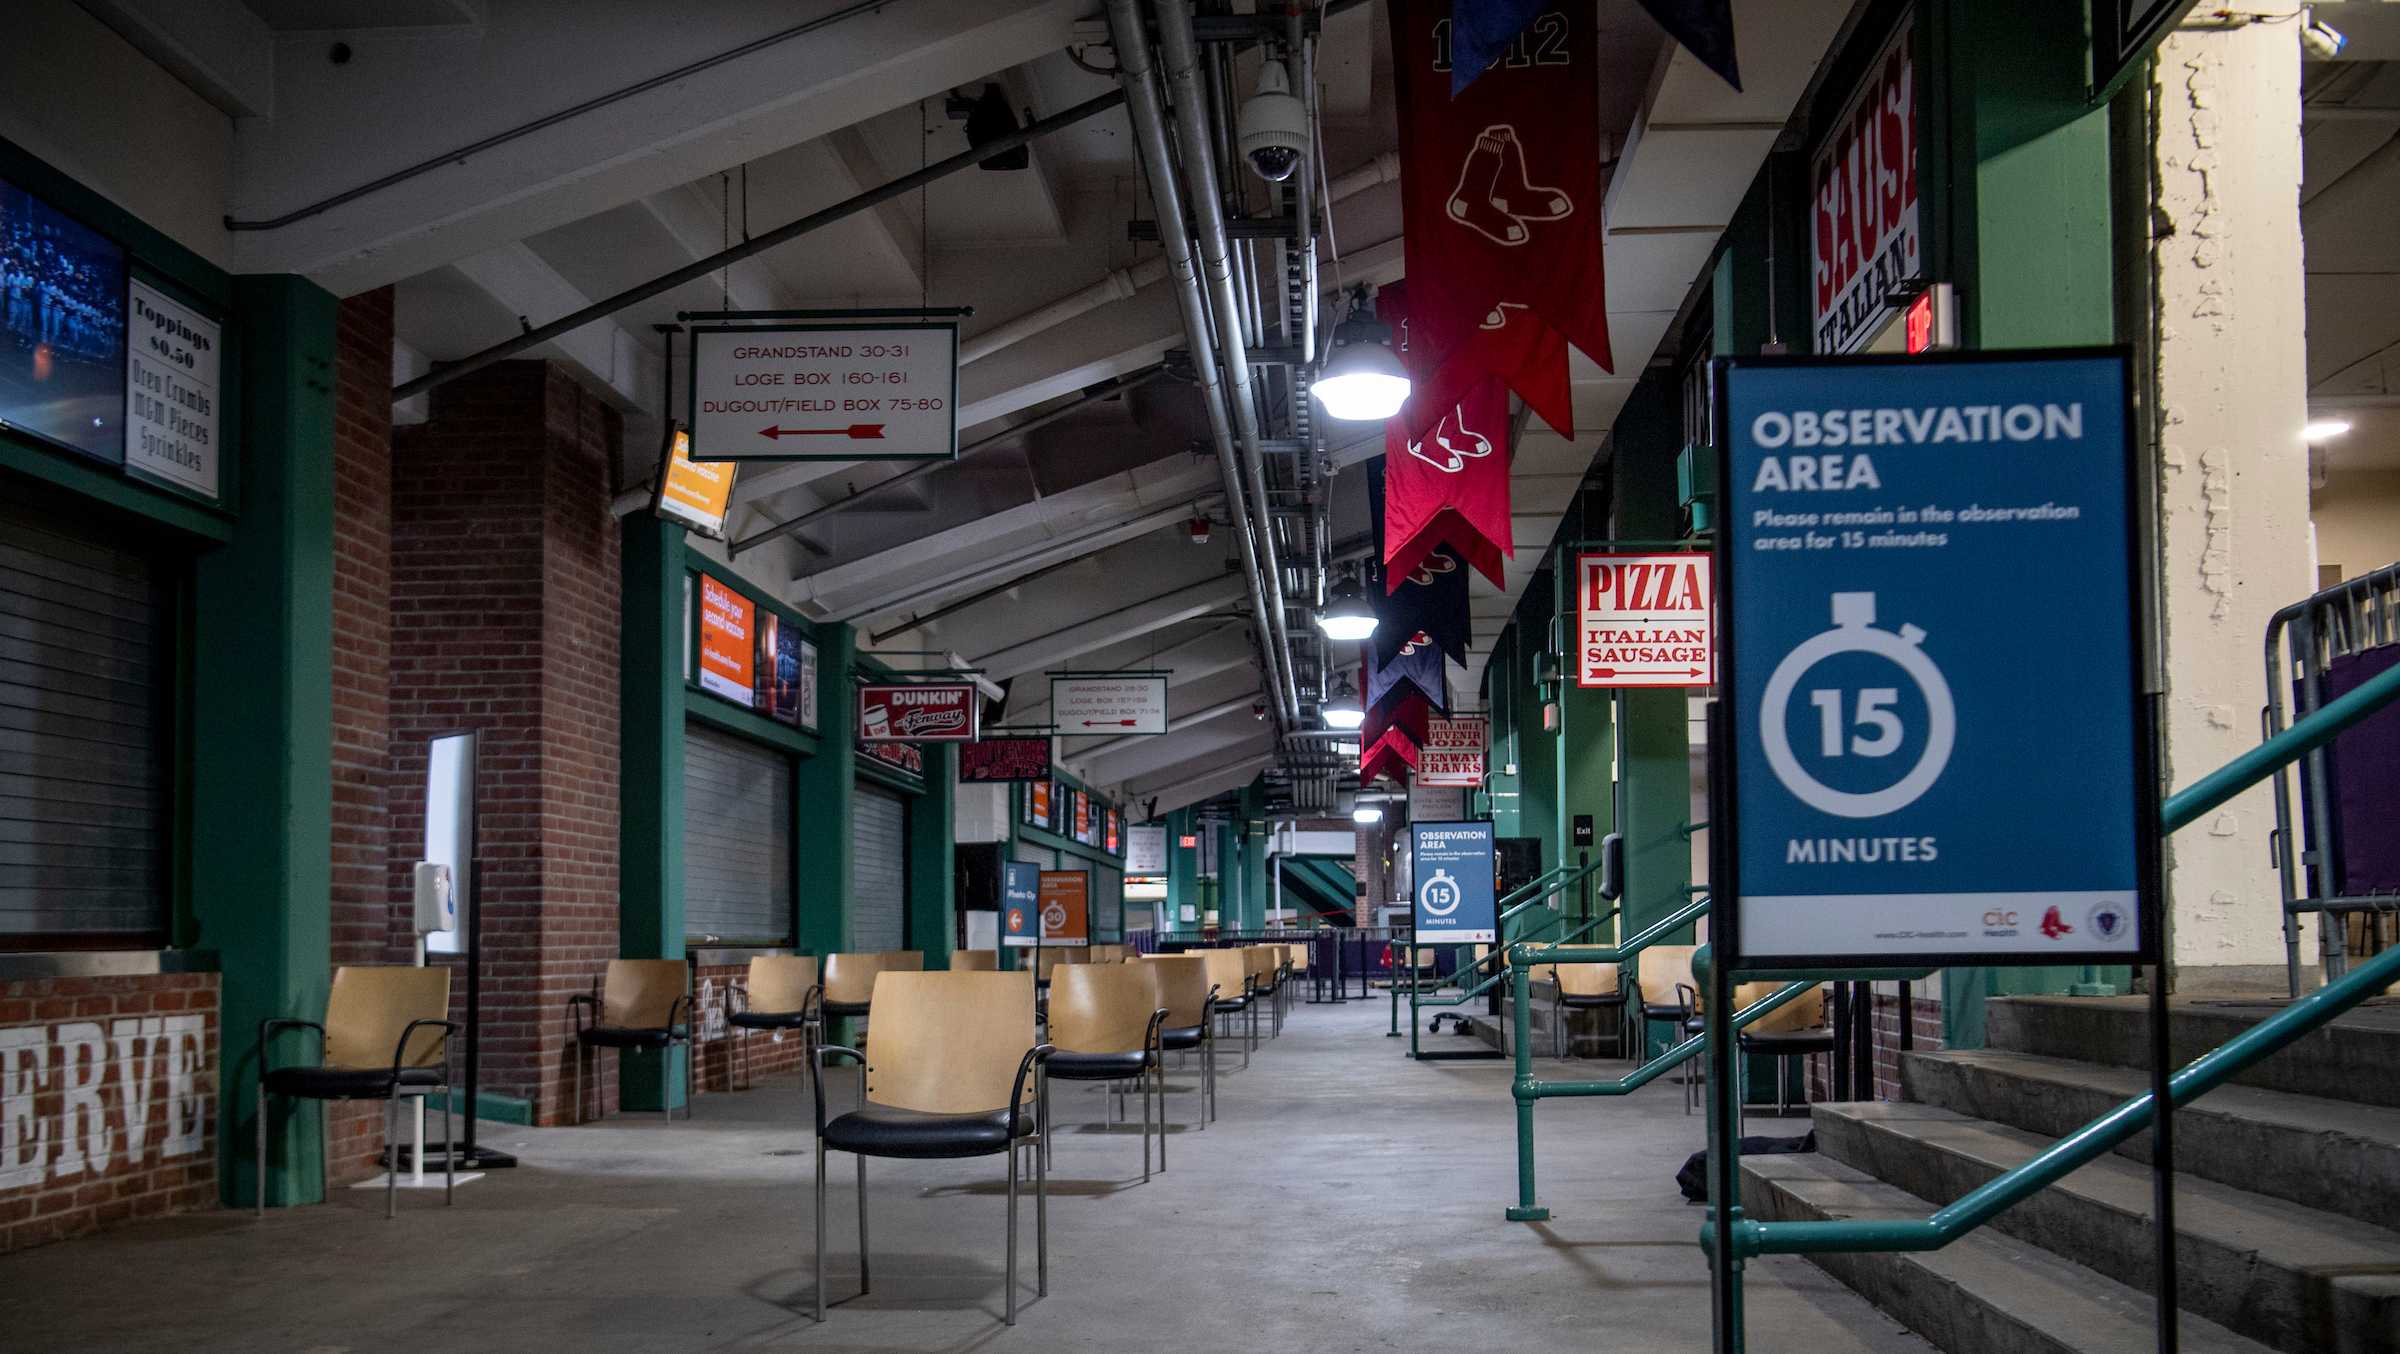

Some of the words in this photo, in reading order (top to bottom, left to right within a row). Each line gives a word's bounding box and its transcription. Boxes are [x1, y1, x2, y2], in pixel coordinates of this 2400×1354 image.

[1432, 12, 1569, 72] 112
[1819, 229, 1907, 355] ITALIAN
[135, 297, 210, 350] Toppings
[151, 335, 194, 369] $0.50
[734, 346, 852, 360] GRANDSTAND
[860, 345, 909, 357] 30-31
[133, 359, 162, 393] Oreo
[166, 375, 210, 417] Crumbs
[735, 373, 784, 385] LOGE
[795, 373, 830, 385] BOX
[842, 371, 907, 384] 160-161
[703, 397, 836, 414] DUGOUT/FIELD
[844, 399, 880, 411] BOX
[890, 398, 943, 410] 75-80
[170, 406, 209, 445] Pieces
[1751, 403, 2082, 448] OBSERVATION
[141, 425, 201, 472] Sprinkles
[1752, 454, 1881, 492] AREA
[1753, 508, 1818, 527] Please
[1823, 507, 1893, 525] remain
[1898, 506, 1918, 523] in
[1920, 505, 1954, 522] the
[1957, 502, 2079, 522] observation
[1754, 536, 1801, 550] area
[1805, 532, 1836, 549] for
[1841, 532, 1864, 547] 15
[1868, 530, 1948, 547] minutes
[1587, 564, 1704, 611] PIZZA
[1588, 630, 1705, 643] ITALIAN
[1587, 648, 1705, 662] SAUSAGE
[891, 691, 963, 706] DUNKIN'
[901, 707, 965, 731] Fenway
[1811, 687, 1904, 757] 15
[1429, 731, 1480, 740] OUVENIR
[1421, 753, 1480, 762] FENWAY
[1421, 763, 1481, 773] FRANKS
[1420, 831, 1486, 840] OBSERVATION
[1420, 841, 1446, 849] AREA
[1786, 837, 1938, 863] MINUTES
[1431, 888, 1450, 903] 15
[1047, 911, 1062, 922] 30
